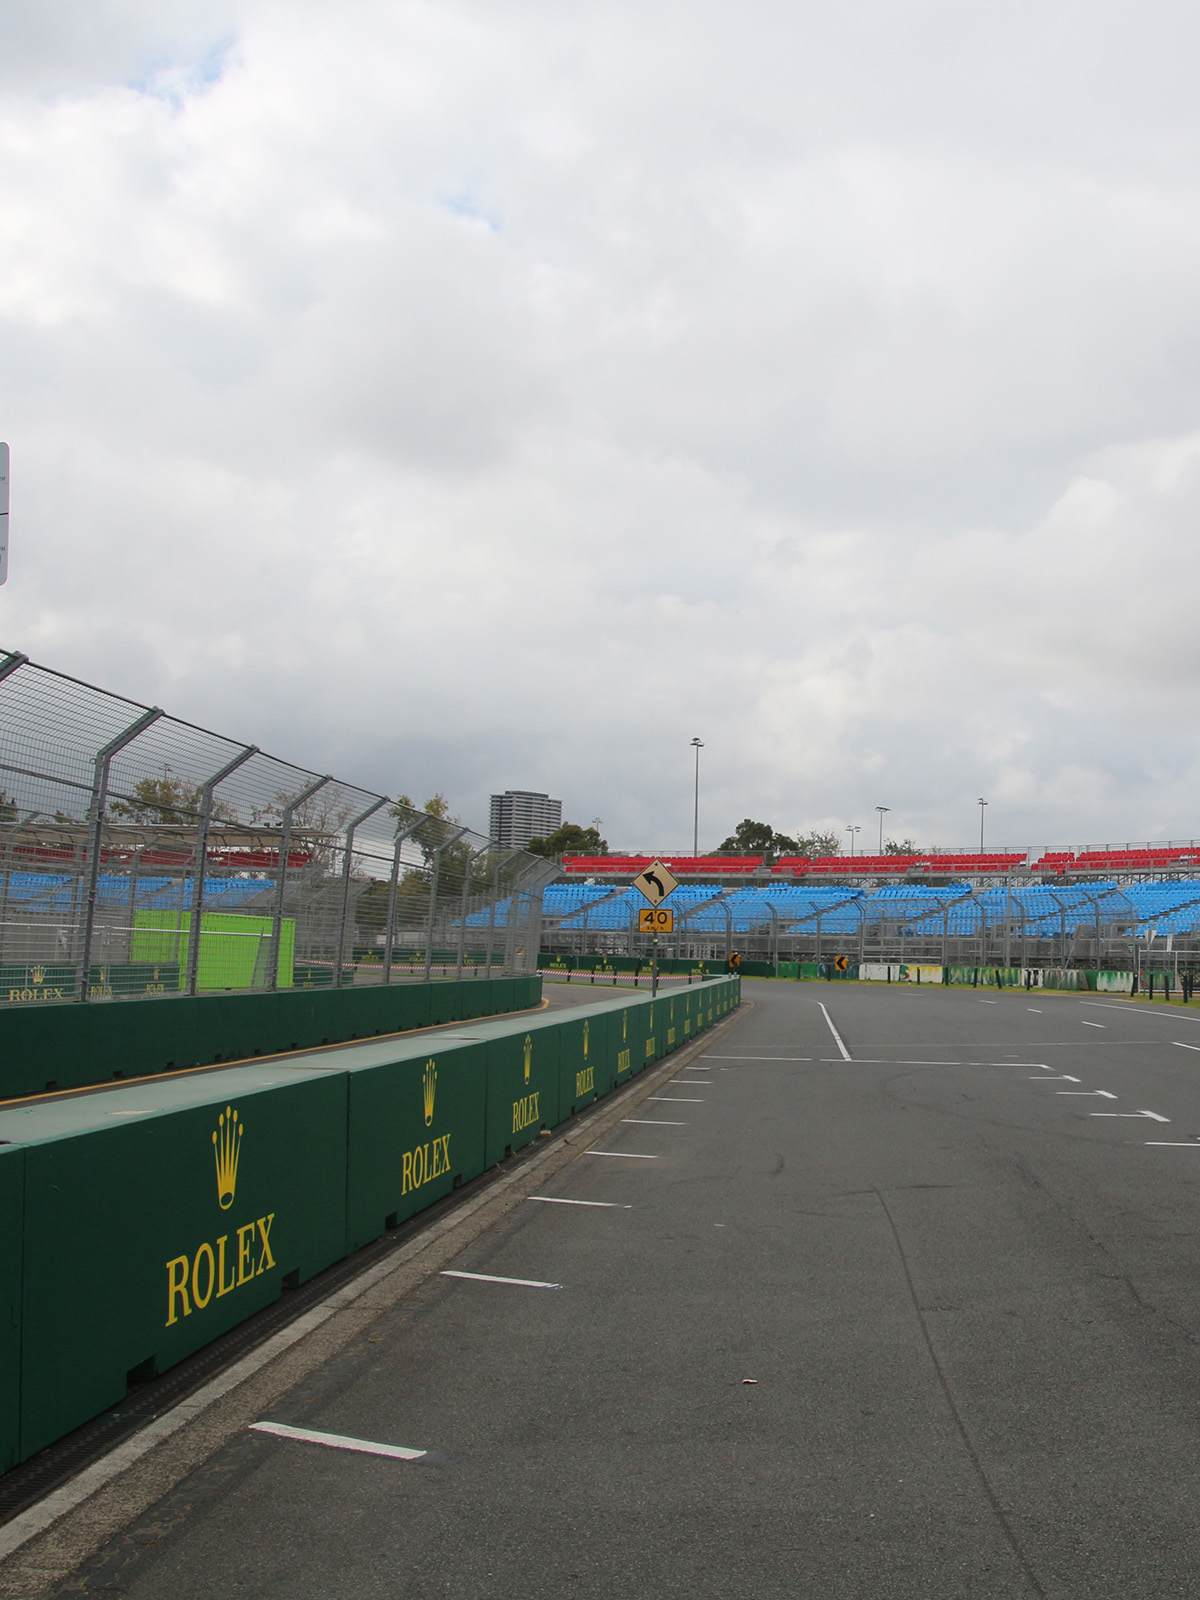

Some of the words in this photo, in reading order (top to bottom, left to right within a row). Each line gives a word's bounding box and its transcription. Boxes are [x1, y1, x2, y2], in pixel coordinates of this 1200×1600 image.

[644, 912, 668, 924] 40
[9, 988, 64, 1001] ROLEX
[576, 1066, 594, 1098] ROLEX
[511, 1092, 539, 1134] ROLEX
[400, 1133, 451, 1196] ROLEX
[165, 1213, 276, 1328] ROLEX
